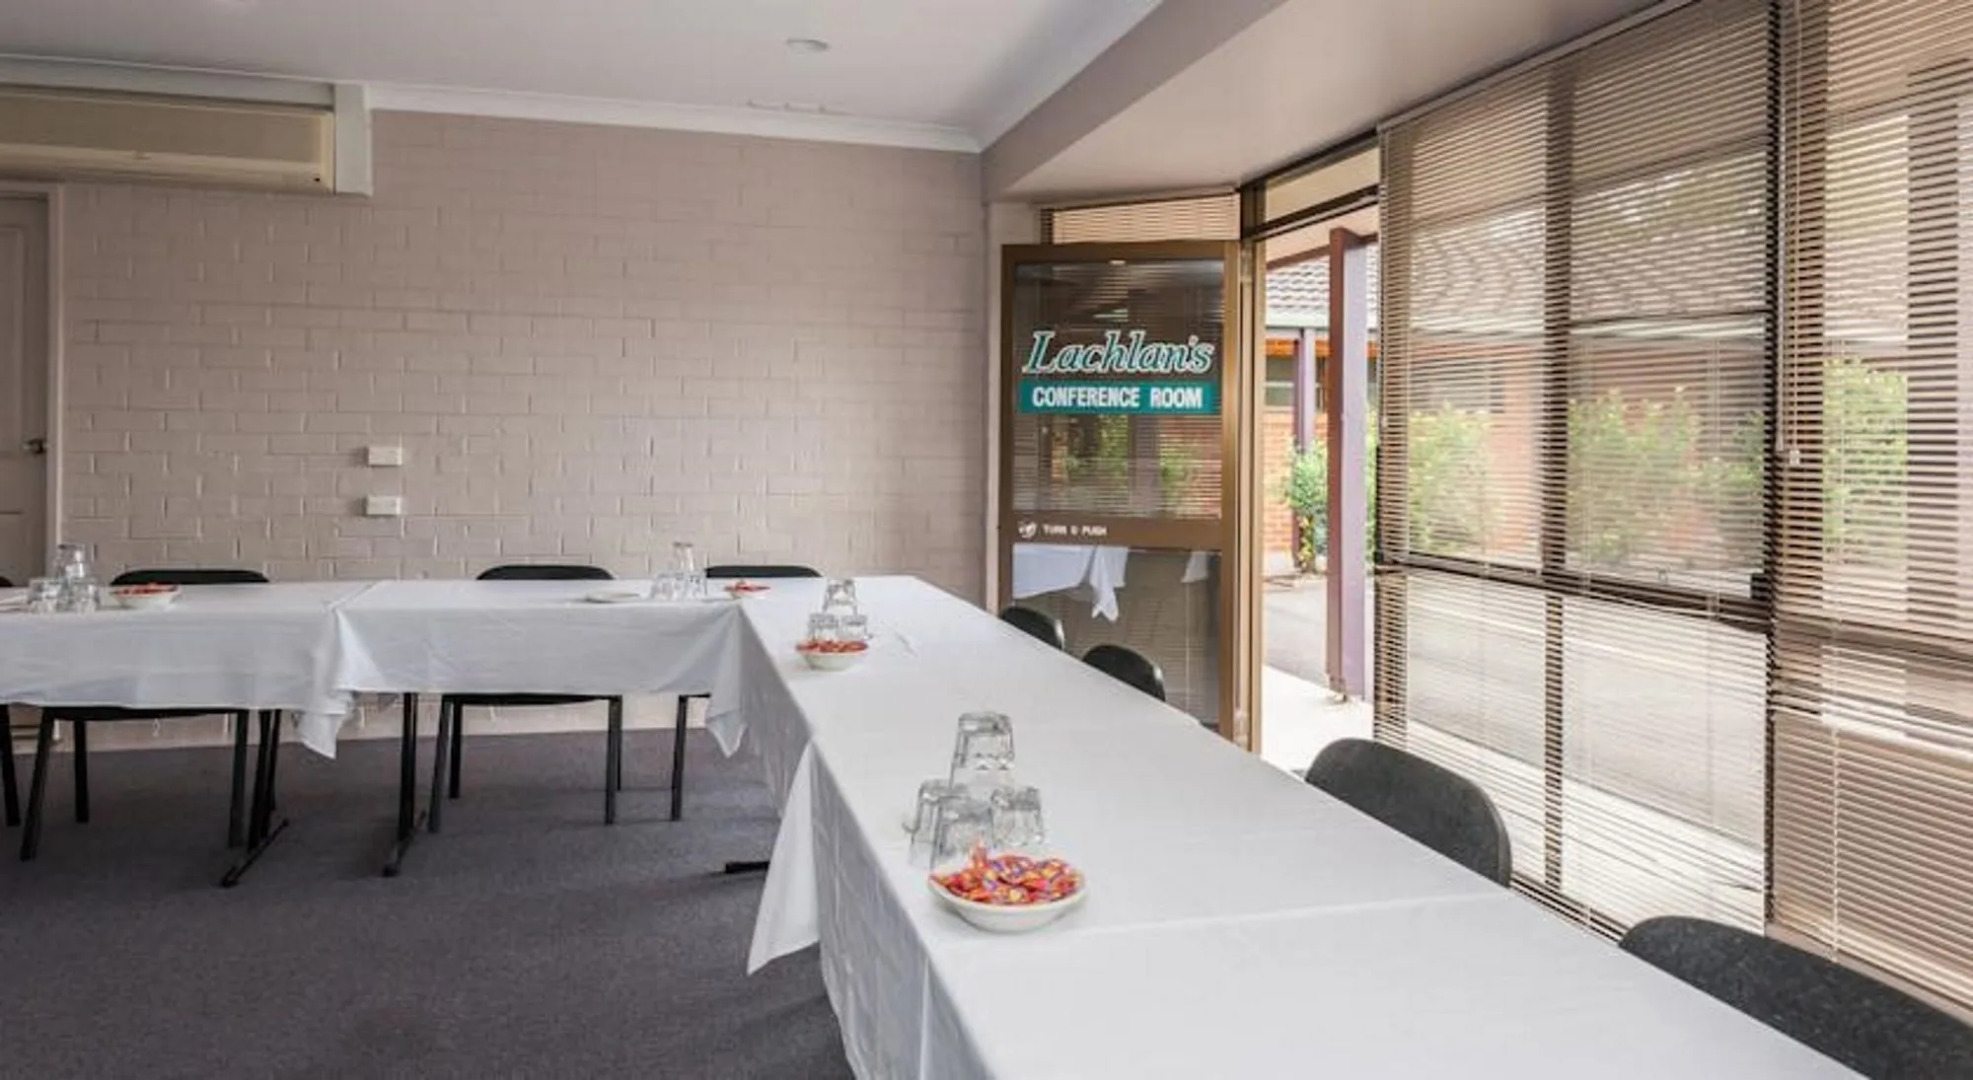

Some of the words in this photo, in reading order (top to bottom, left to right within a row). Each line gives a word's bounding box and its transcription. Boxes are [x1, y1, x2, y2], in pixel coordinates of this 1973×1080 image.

[1022, 330, 1214, 374] Lachlan's
[1032, 386, 1141, 408] CONFERENCE
[1150, 387, 1203, 409] ROOM
[1081, 524, 1107, 536] PUSH
